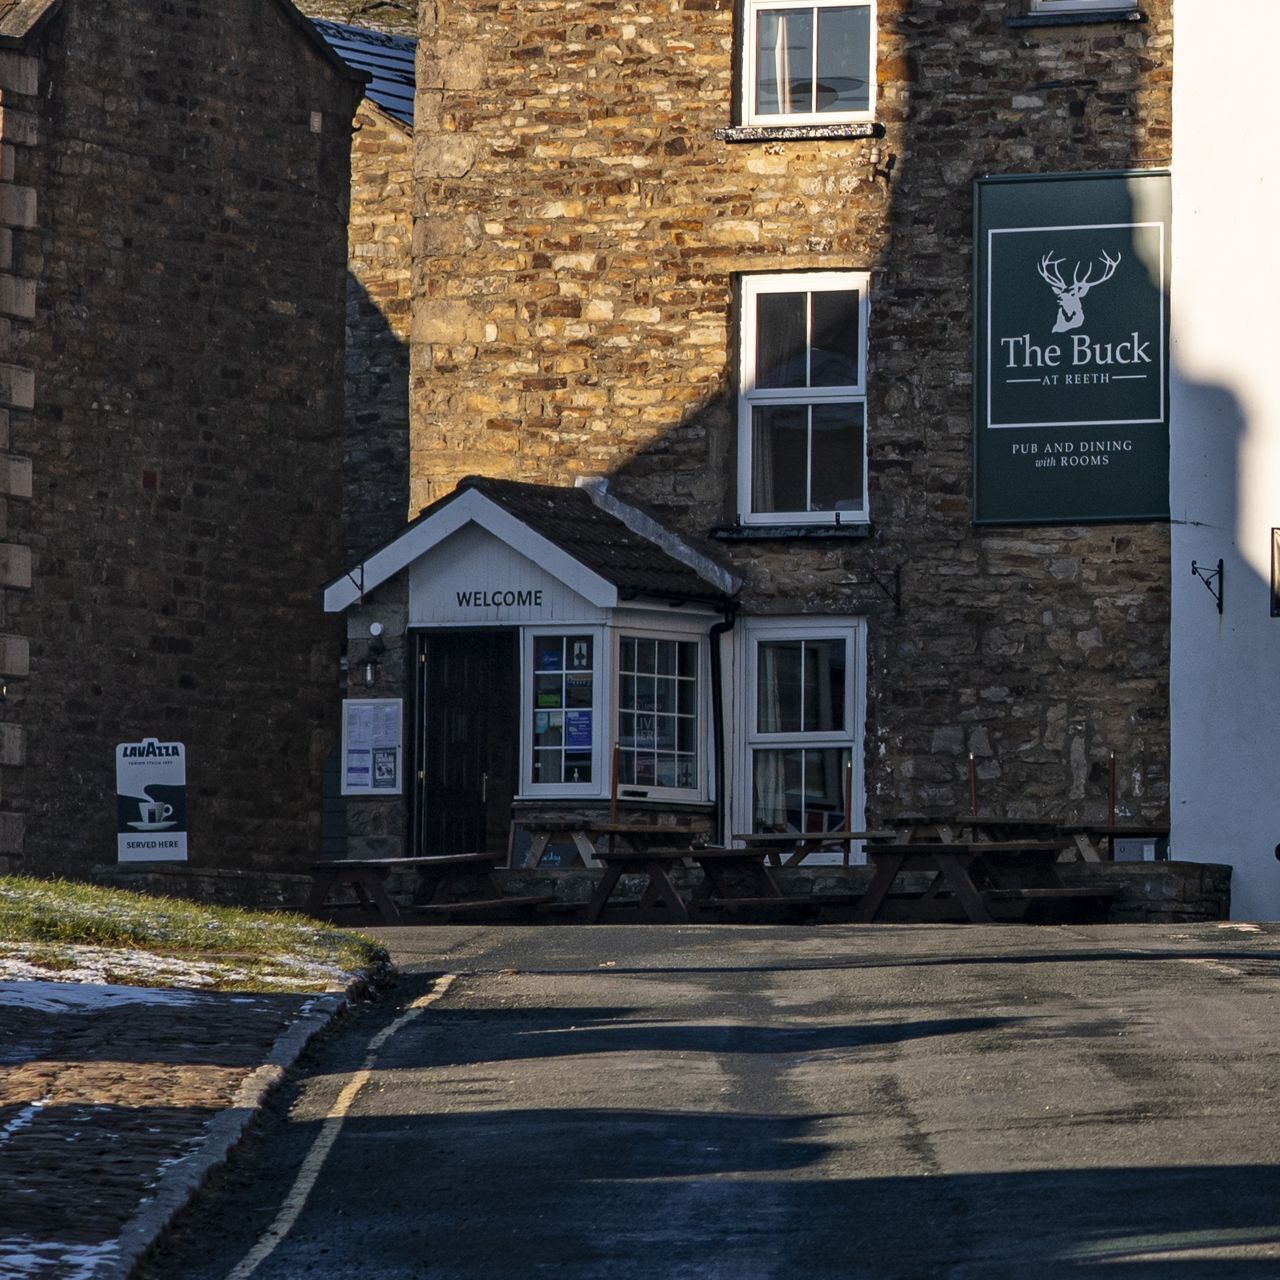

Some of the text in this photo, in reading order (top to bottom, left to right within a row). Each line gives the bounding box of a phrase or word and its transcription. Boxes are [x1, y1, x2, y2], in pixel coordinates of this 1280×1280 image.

[1001, 331, 1152, 367] The Buck
[1042, 373, 1109, 385] AT REETH
[1012, 440, 1132, 454] PUB AND DINING
[1035, 455, 1110, 467] with ROOMS
[456, 590, 542, 607] WELCOME
[126, 840, 179, 849] SERVED HERE
